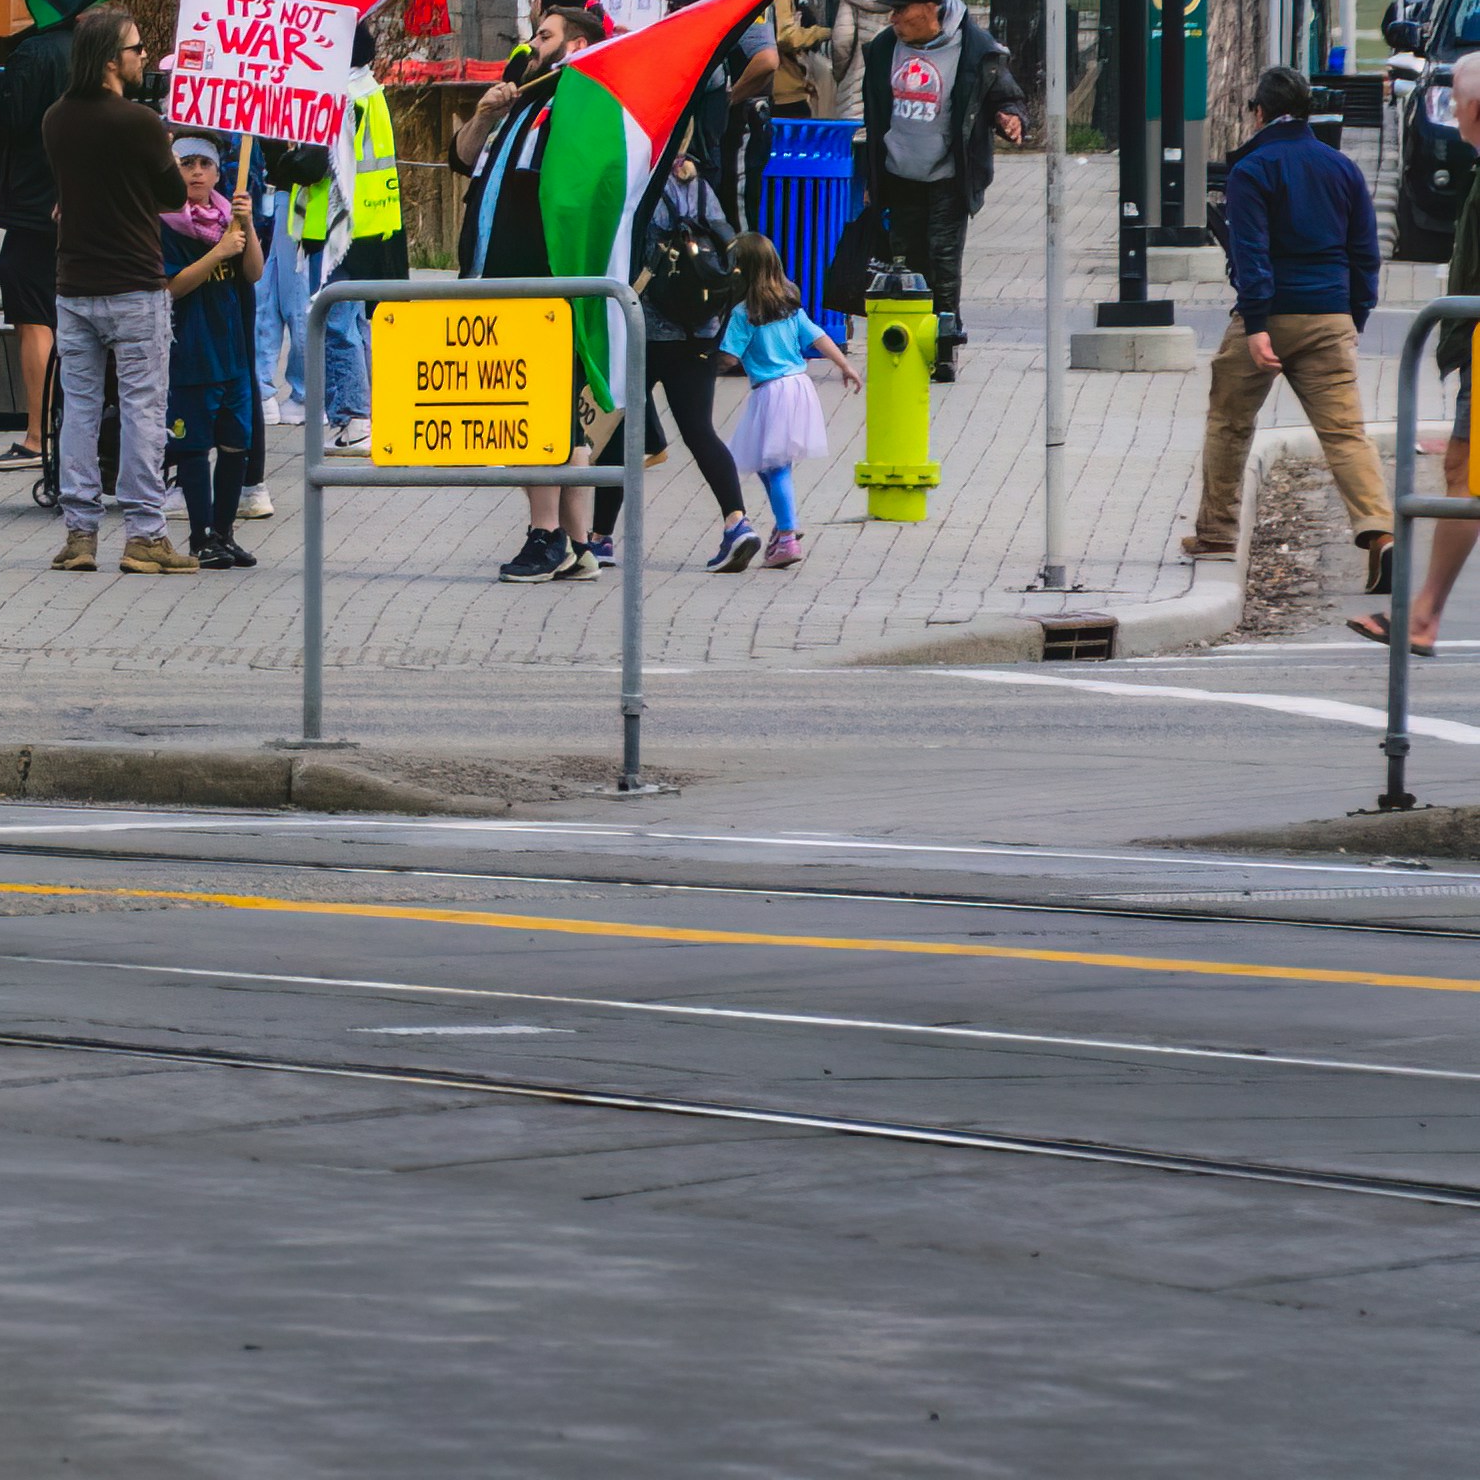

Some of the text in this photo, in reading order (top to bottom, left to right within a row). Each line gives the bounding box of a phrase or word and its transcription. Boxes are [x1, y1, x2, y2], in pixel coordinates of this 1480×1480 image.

[280, 1, 337, 33] NOT
[238, 61, 290, 84] IT'S
[172, 74, 348, 145] EXTERMINATION
[893, 99, 937, 122] 2023
[445, 315, 498, 347] LOOK
[416, 358, 527, 391] BOTH WAYS
[413, 418, 529, 450] FOR TRAINS
